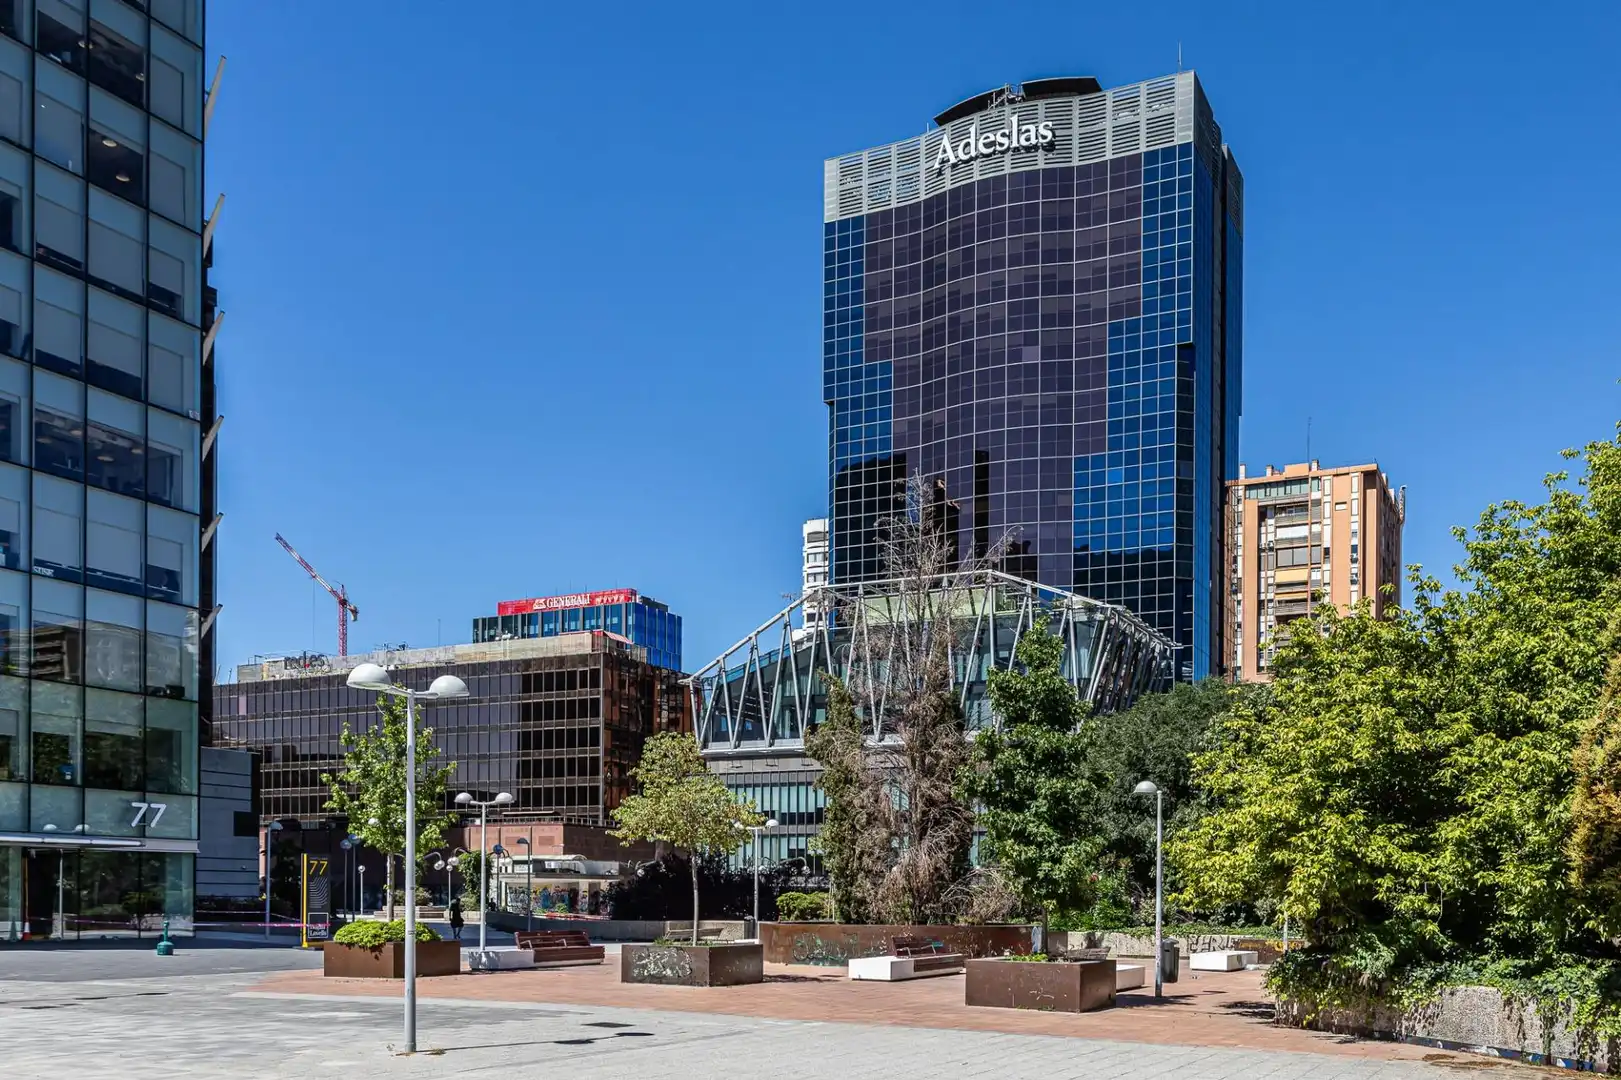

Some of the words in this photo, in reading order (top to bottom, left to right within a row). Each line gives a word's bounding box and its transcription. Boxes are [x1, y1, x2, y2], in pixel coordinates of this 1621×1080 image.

[933, 112, 1053, 169] Adeslas
[546, 593, 591, 608] GENERALI
[131, 802, 167, 828] 77
[309, 860, 328, 875] 77
